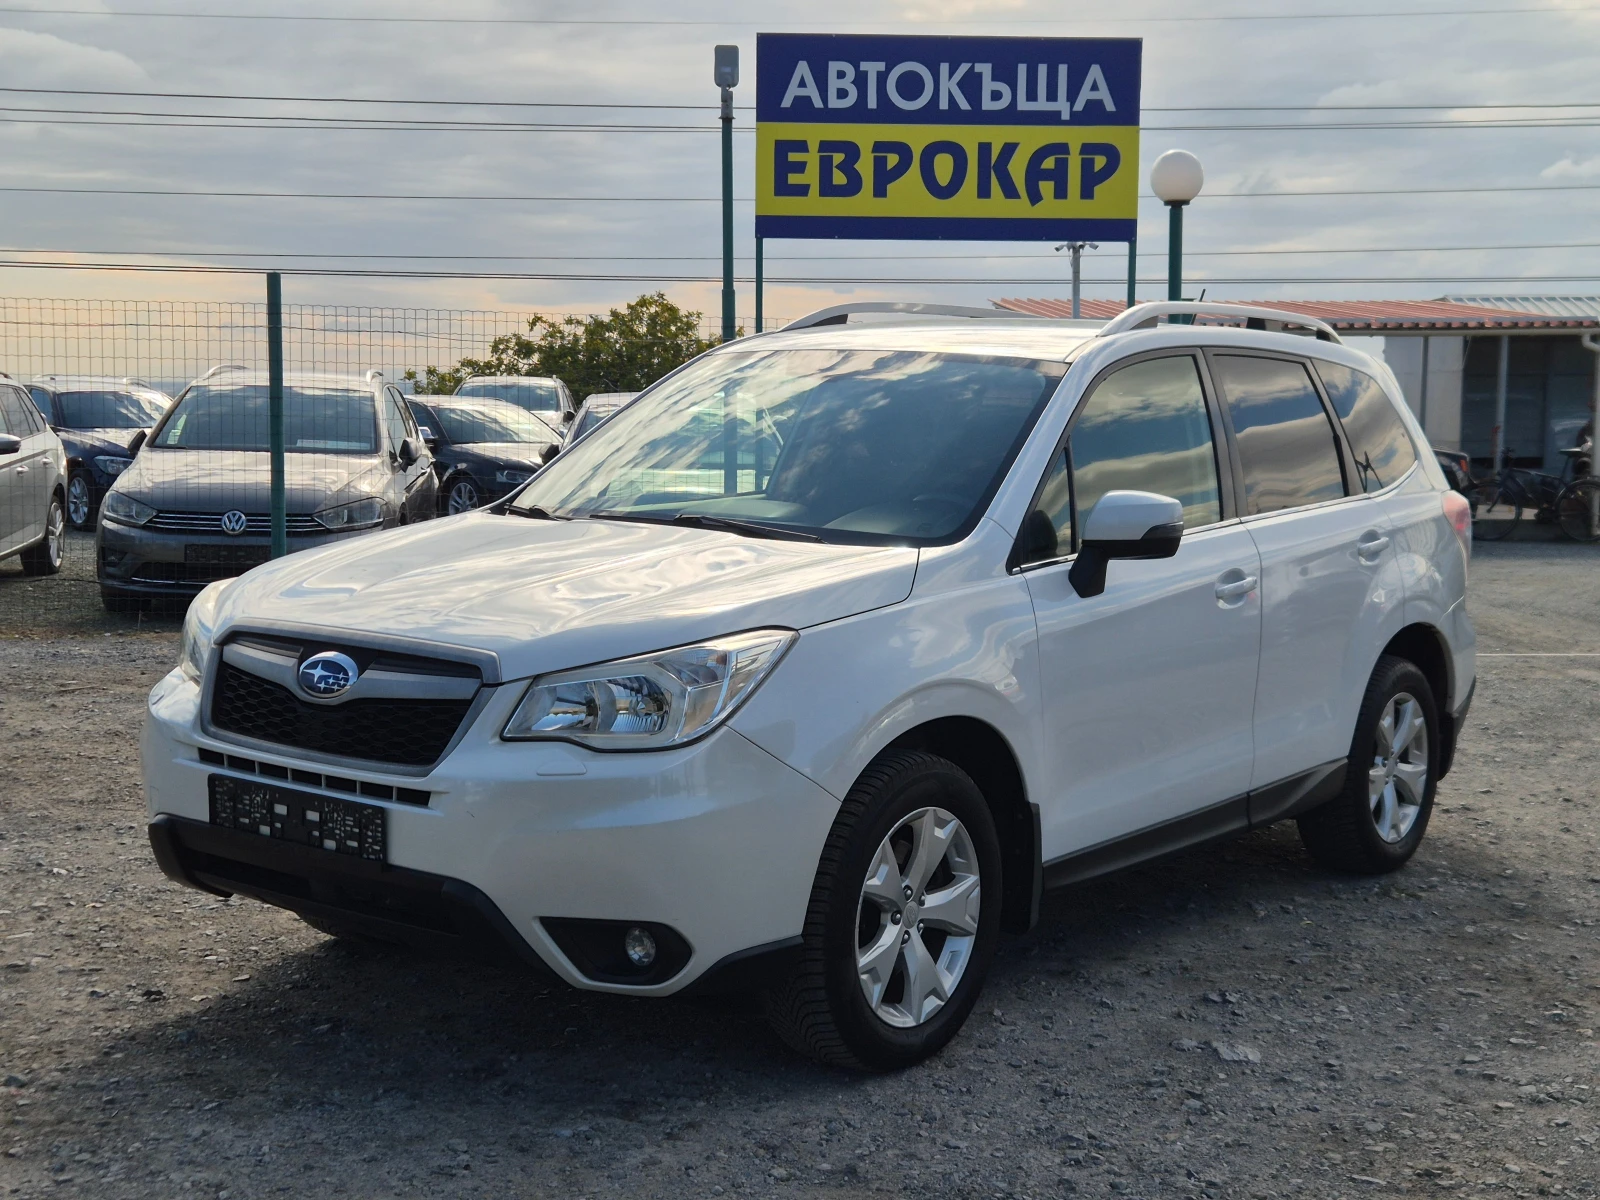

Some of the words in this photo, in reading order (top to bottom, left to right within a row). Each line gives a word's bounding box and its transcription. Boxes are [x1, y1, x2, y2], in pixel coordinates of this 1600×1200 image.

[780, 60, 1116, 120] АВТОКЪЩА
[773, 139, 1121, 207] ЕВРОКАР
[222, 511, 246, 533] VW
